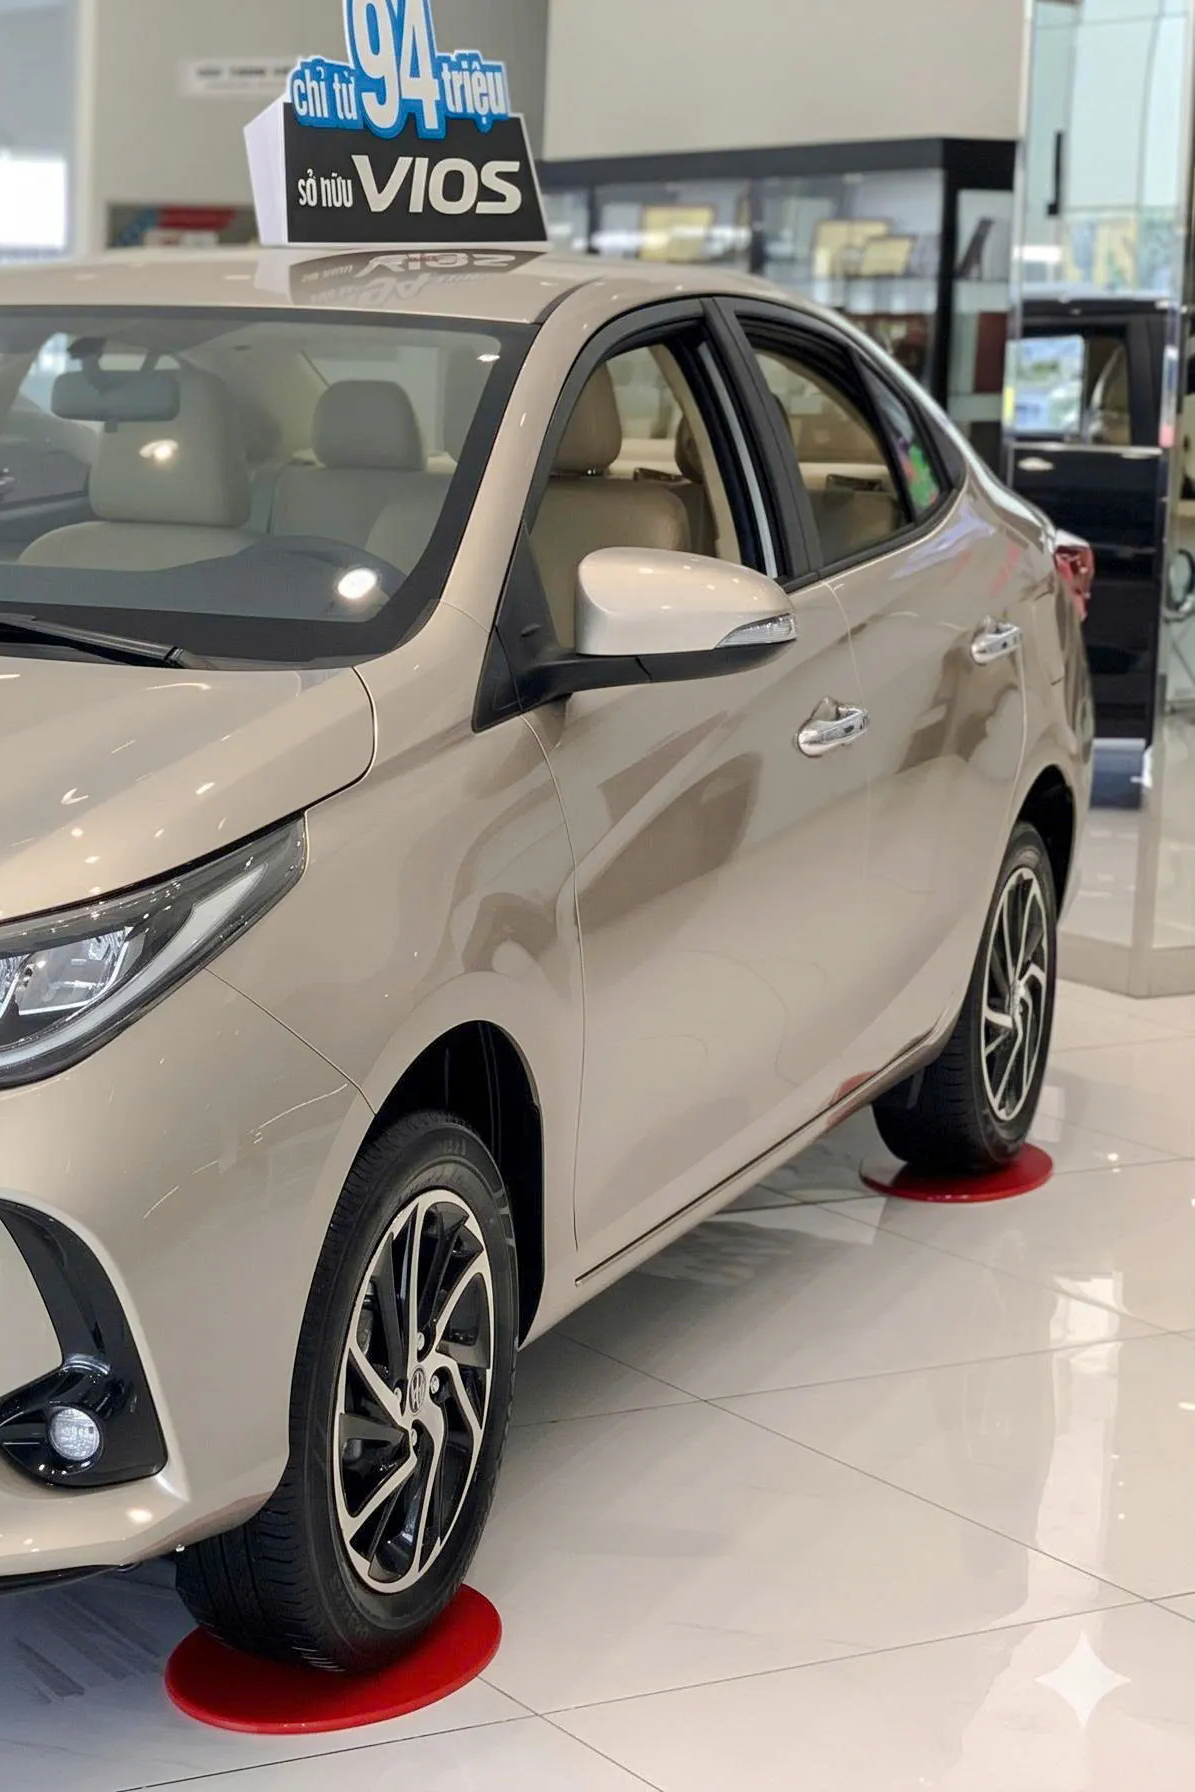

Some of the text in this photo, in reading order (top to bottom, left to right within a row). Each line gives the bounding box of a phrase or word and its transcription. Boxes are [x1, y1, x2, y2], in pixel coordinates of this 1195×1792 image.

[293, 0, 507, 129] chỉ từ 94 triệu
[297, 168, 318, 207] sở
[351, 154, 522, 215] VIOS
